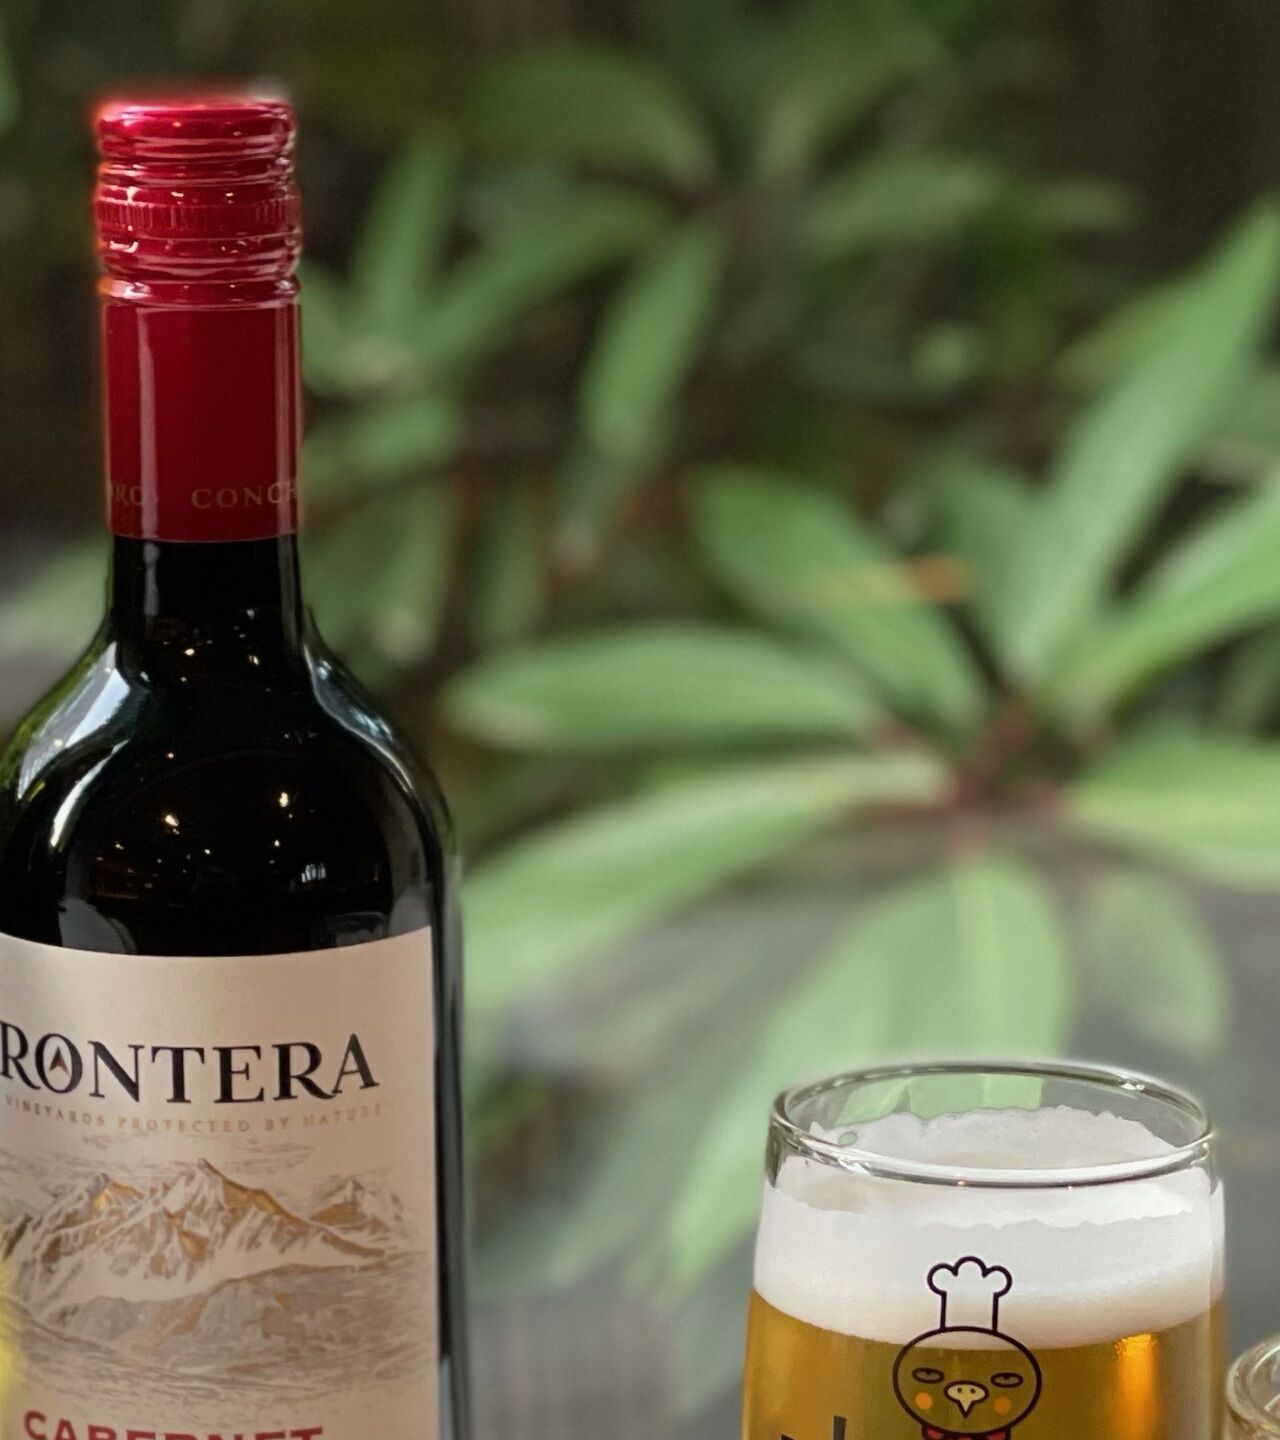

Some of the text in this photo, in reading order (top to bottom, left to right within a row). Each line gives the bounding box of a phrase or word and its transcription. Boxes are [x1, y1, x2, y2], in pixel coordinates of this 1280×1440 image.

[6, 1094, 382, 1133] VINEYARDS PROTECTED BY NATURE
